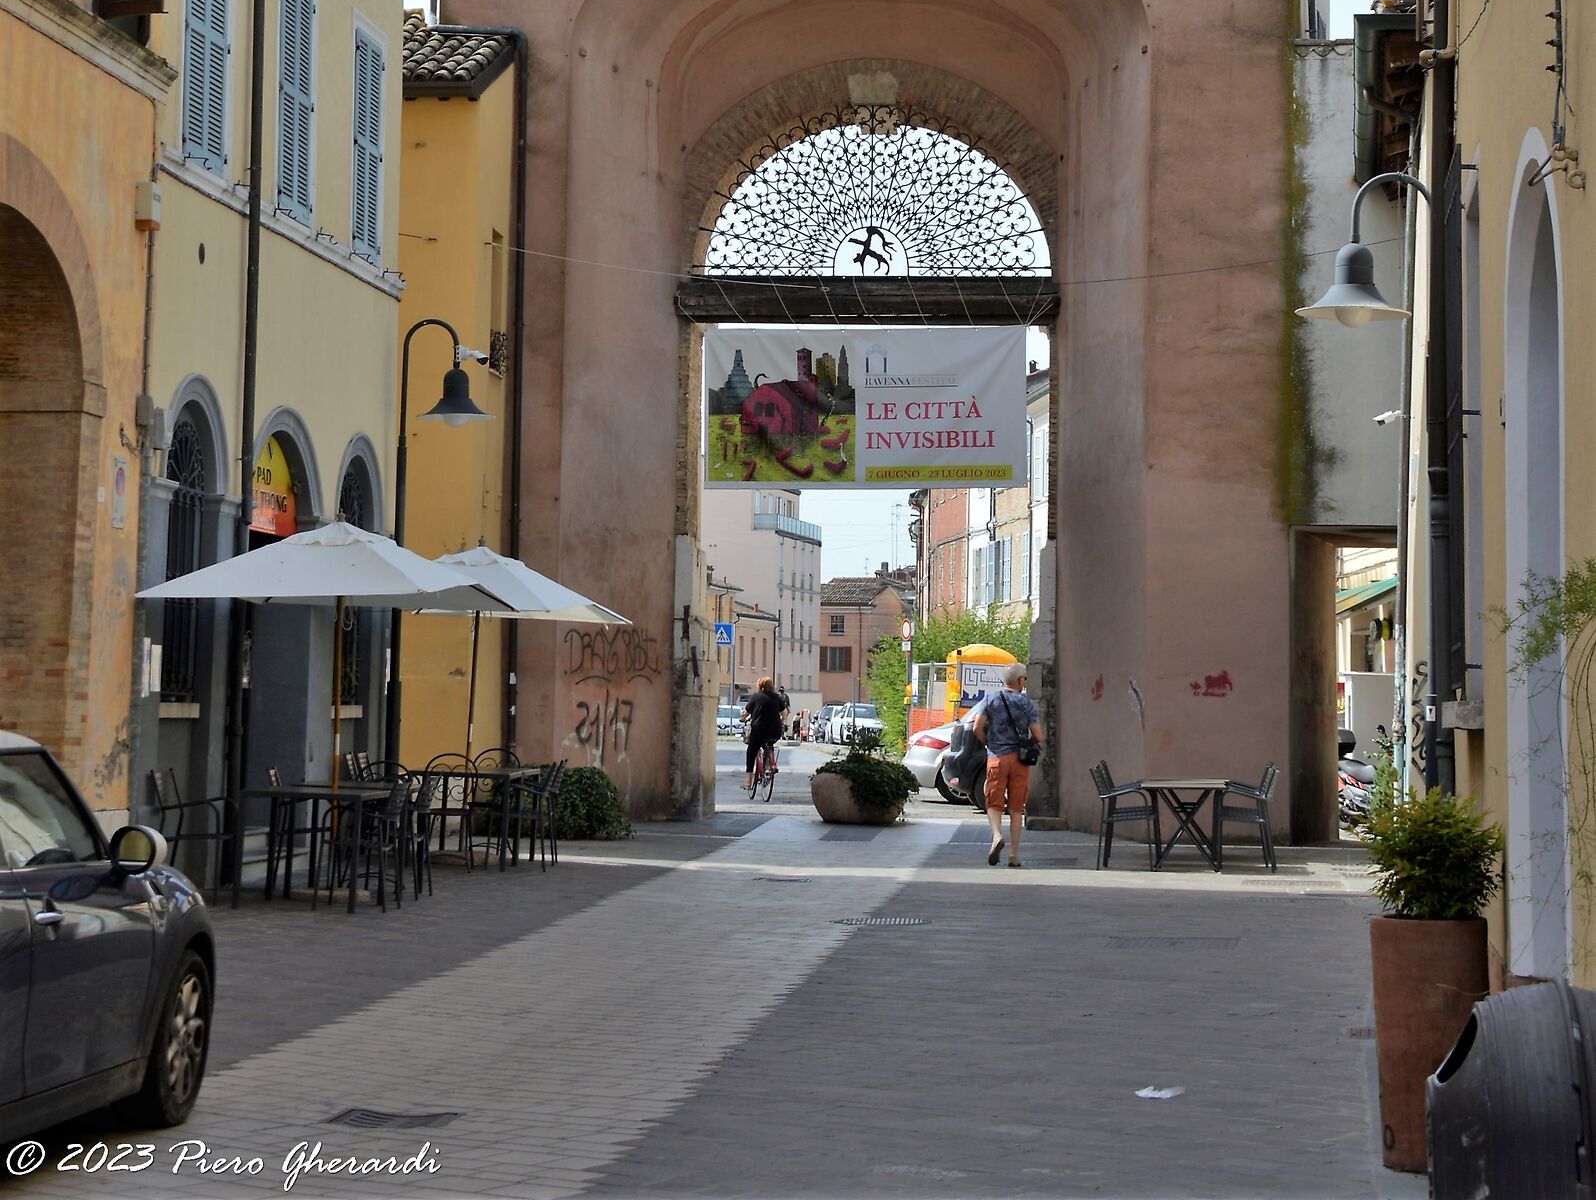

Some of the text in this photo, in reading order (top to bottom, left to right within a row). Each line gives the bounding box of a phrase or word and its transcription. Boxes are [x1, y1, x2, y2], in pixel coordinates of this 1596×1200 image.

[866, 395, 983, 420] LE CITTÀ
[866, 430, 996, 449] INVISIBILI
[868, 470, 874, 479] 7
[876, 470, 920, 480] GIUGNO
[928, 470, 940, 479] 23
[941, 469, 983, 479] LUGLIO
[985, 469, 1007, 478] 2023
